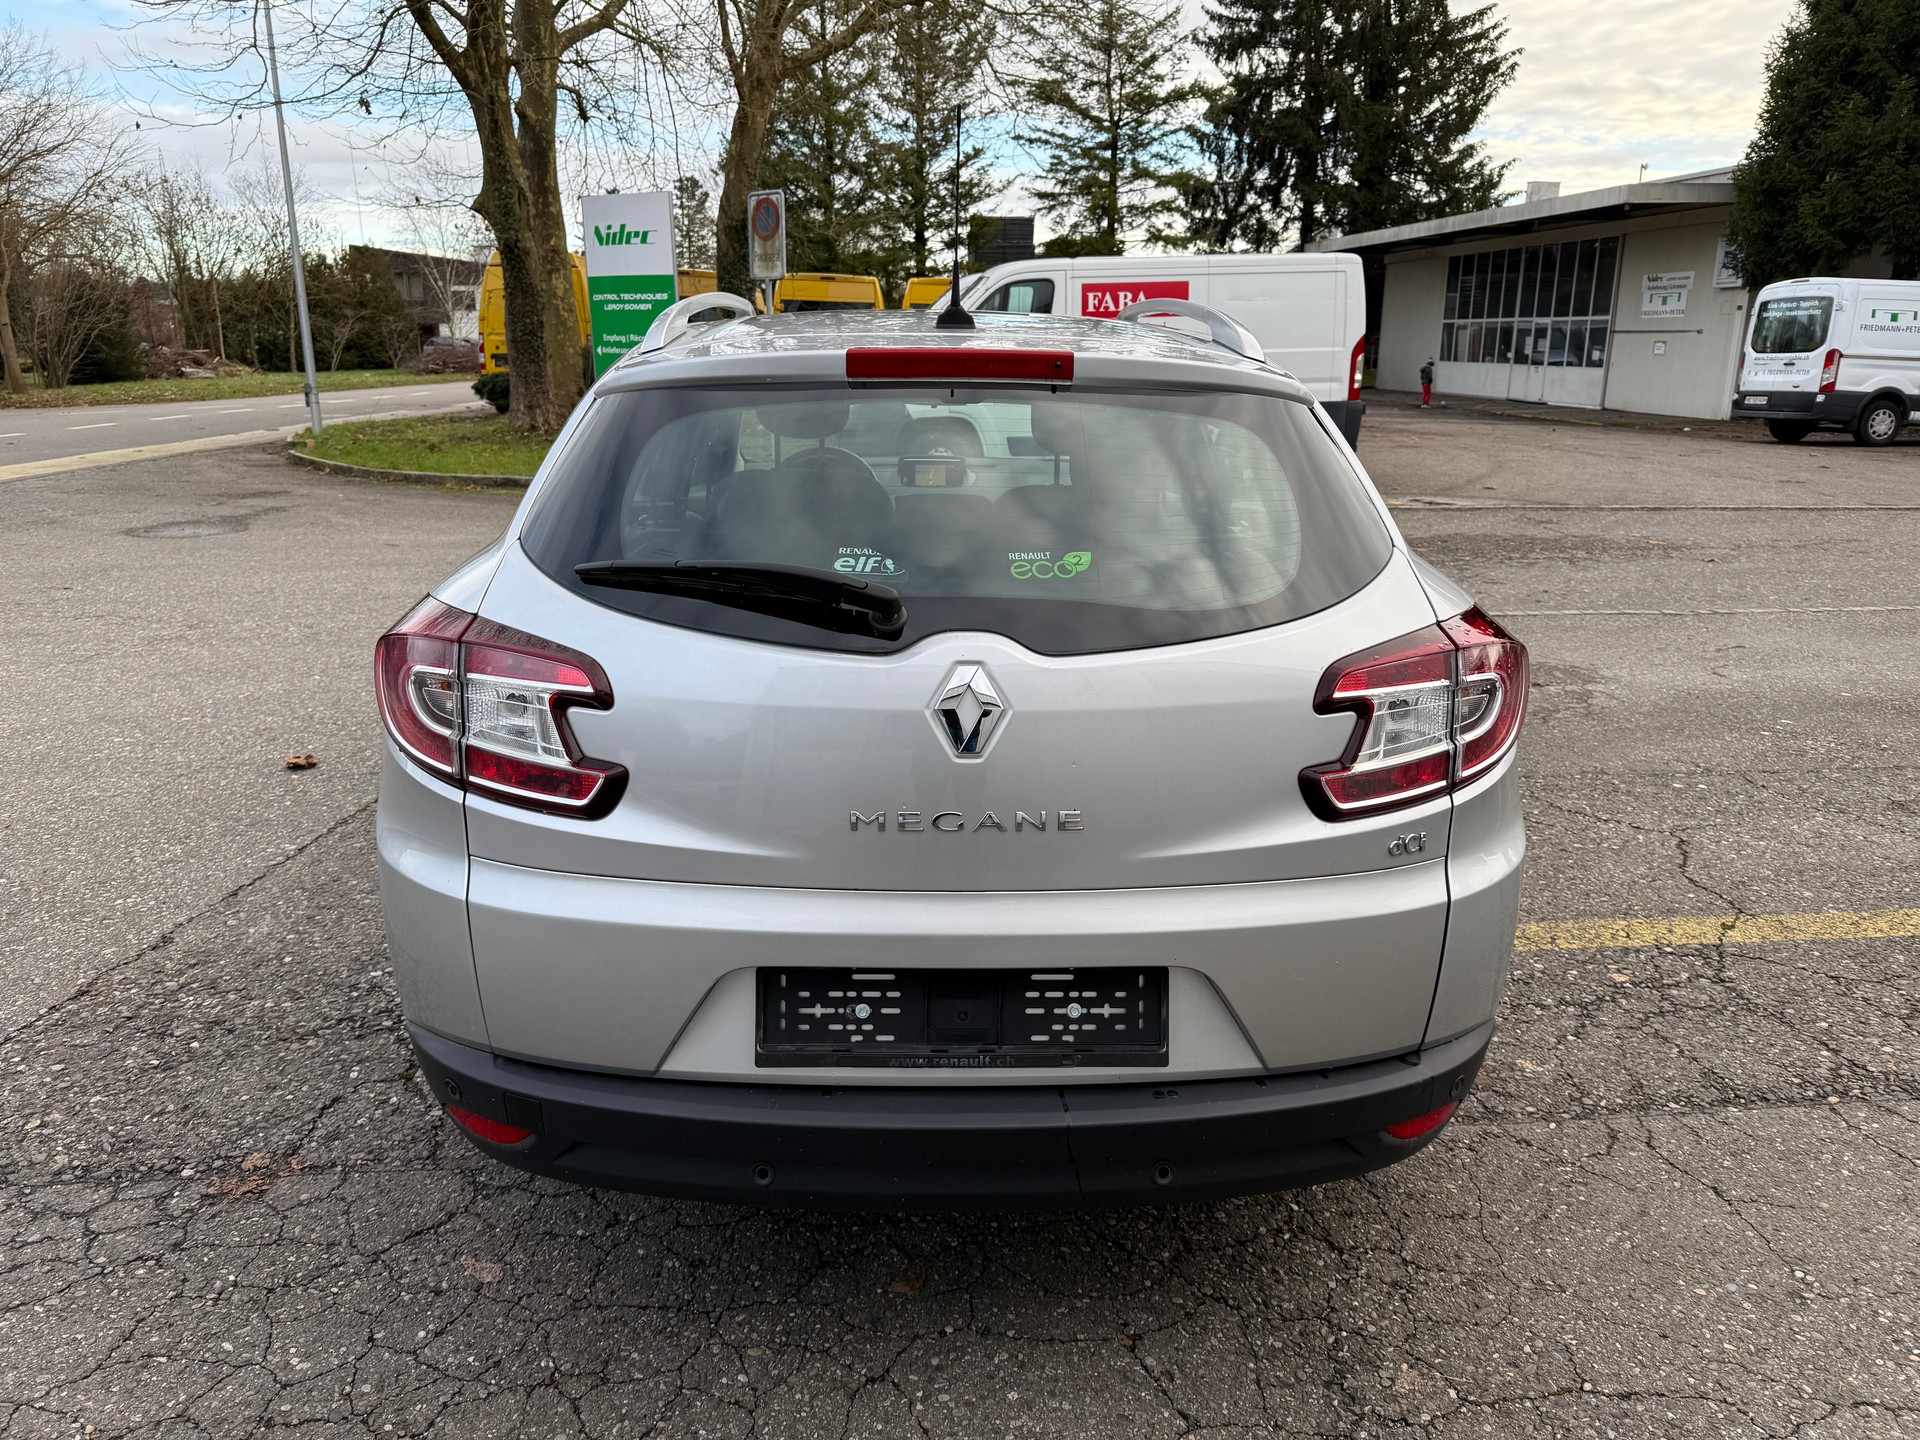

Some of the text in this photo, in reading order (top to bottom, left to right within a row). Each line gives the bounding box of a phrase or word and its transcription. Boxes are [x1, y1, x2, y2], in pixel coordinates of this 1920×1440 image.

[593, 224, 658, 247] Nidec
[592, 292, 669, 301] CONTROL TECHNIQUES
[603, 303, 653, 311] LEROY-SOMER
[603, 333, 627, 343] Empfang
[838, 547, 881, 555] RENAU
[1008, 551, 1051, 560] RENAULT
[834, 556, 882, 573] elf
[1388, 831, 1427, 856] dCi
[887, 1055, 1016, 1067] www.renault.ch
